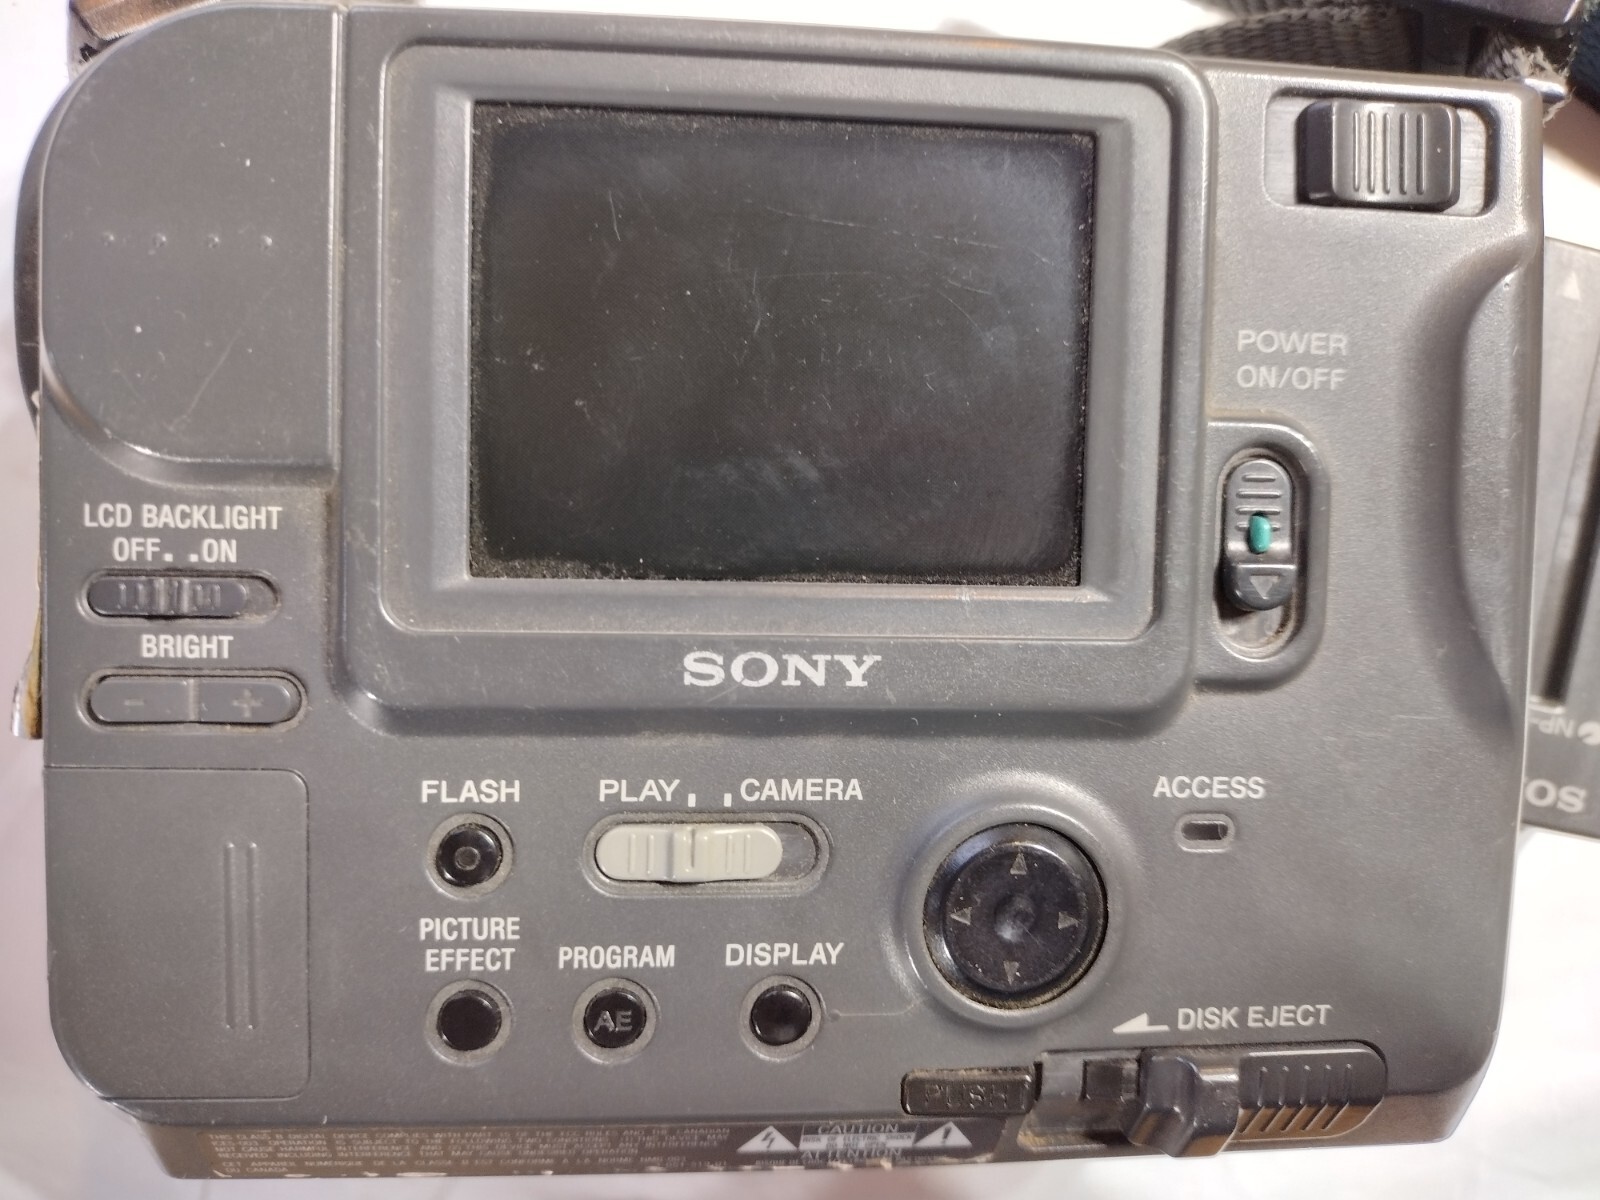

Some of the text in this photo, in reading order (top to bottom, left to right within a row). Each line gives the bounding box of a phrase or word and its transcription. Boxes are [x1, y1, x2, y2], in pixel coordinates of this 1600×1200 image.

[1237, 329, 1348, 356] POWER
[1236, 364, 1346, 391] ON/OFF
[83, 503, 282, 531] LCD BACKLIGHT
[112, 537, 238, 563] OFF ON
[140, 635, 234, 659] BRIGHT
[683, 650, 882, 688] SONY
[1528, 715, 1575, 739] NP-
[420, 779, 521, 803] FLASH
[599, 778, 864, 803] PLAY CAMERA
[1152, 775, 1266, 800] ACCESS
[1525, 778, 1587, 813] SO
[419, 916, 521, 941] PICTURE
[424, 947, 516, 973] EFFECT
[558, 944, 676, 970] PROGRAM
[725, 942, 845, 967] DISPLAY
[593, 1009, 633, 1033] AE
[1177, 1003, 1332, 1031] DISK EJECT
[817, 1123, 899, 1135] CAUTION
[800, 1147, 903, 1160] ATTENTION
